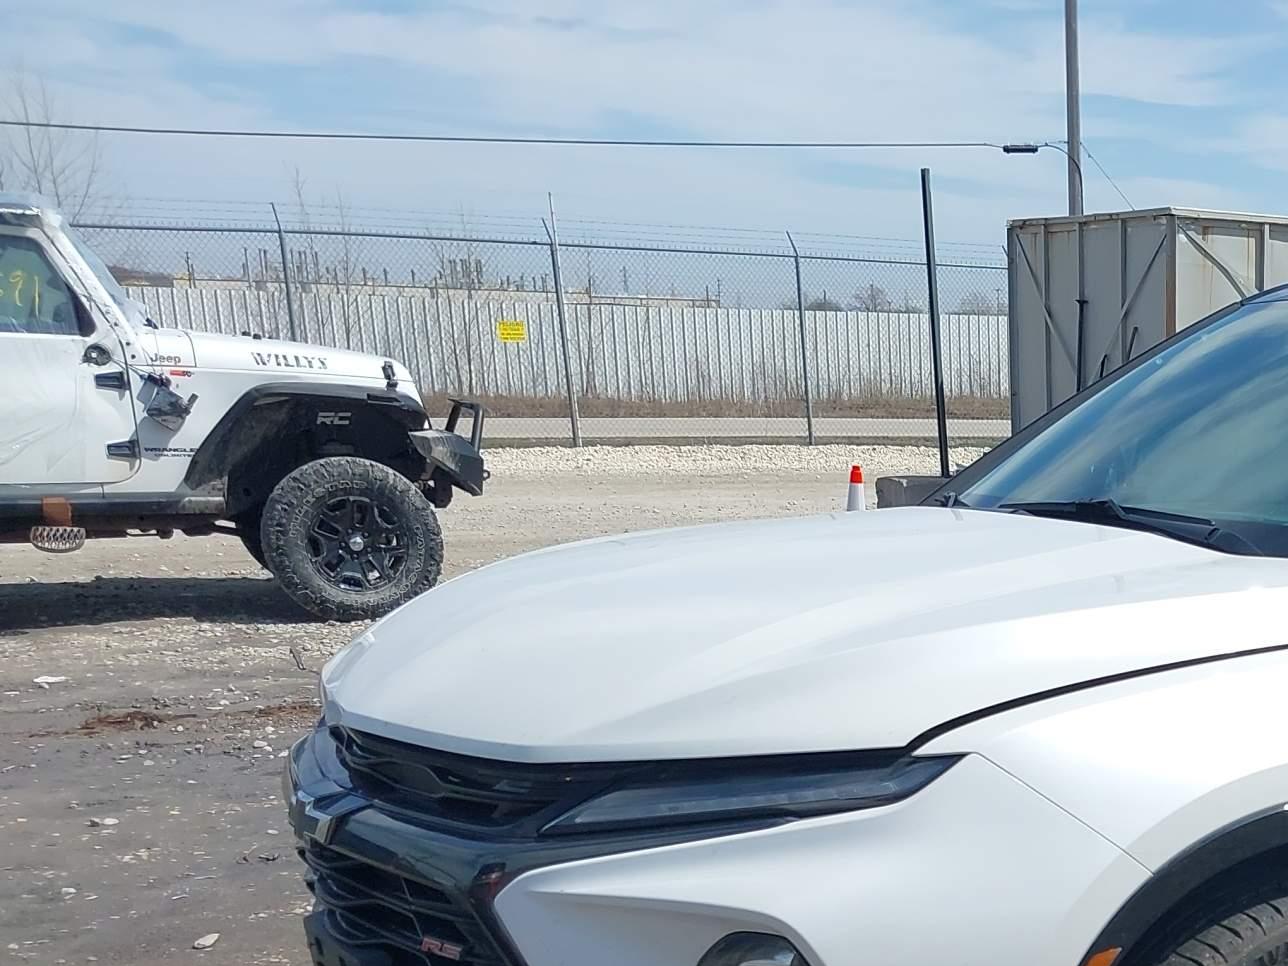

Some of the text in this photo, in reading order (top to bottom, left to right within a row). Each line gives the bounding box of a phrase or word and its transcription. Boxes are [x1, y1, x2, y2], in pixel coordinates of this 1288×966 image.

[150, 353, 182, 364] Jeep
[251, 352, 328, 370] WILLYS
[316, 411, 352, 425] RC
[421, 937, 462, 960] RS
